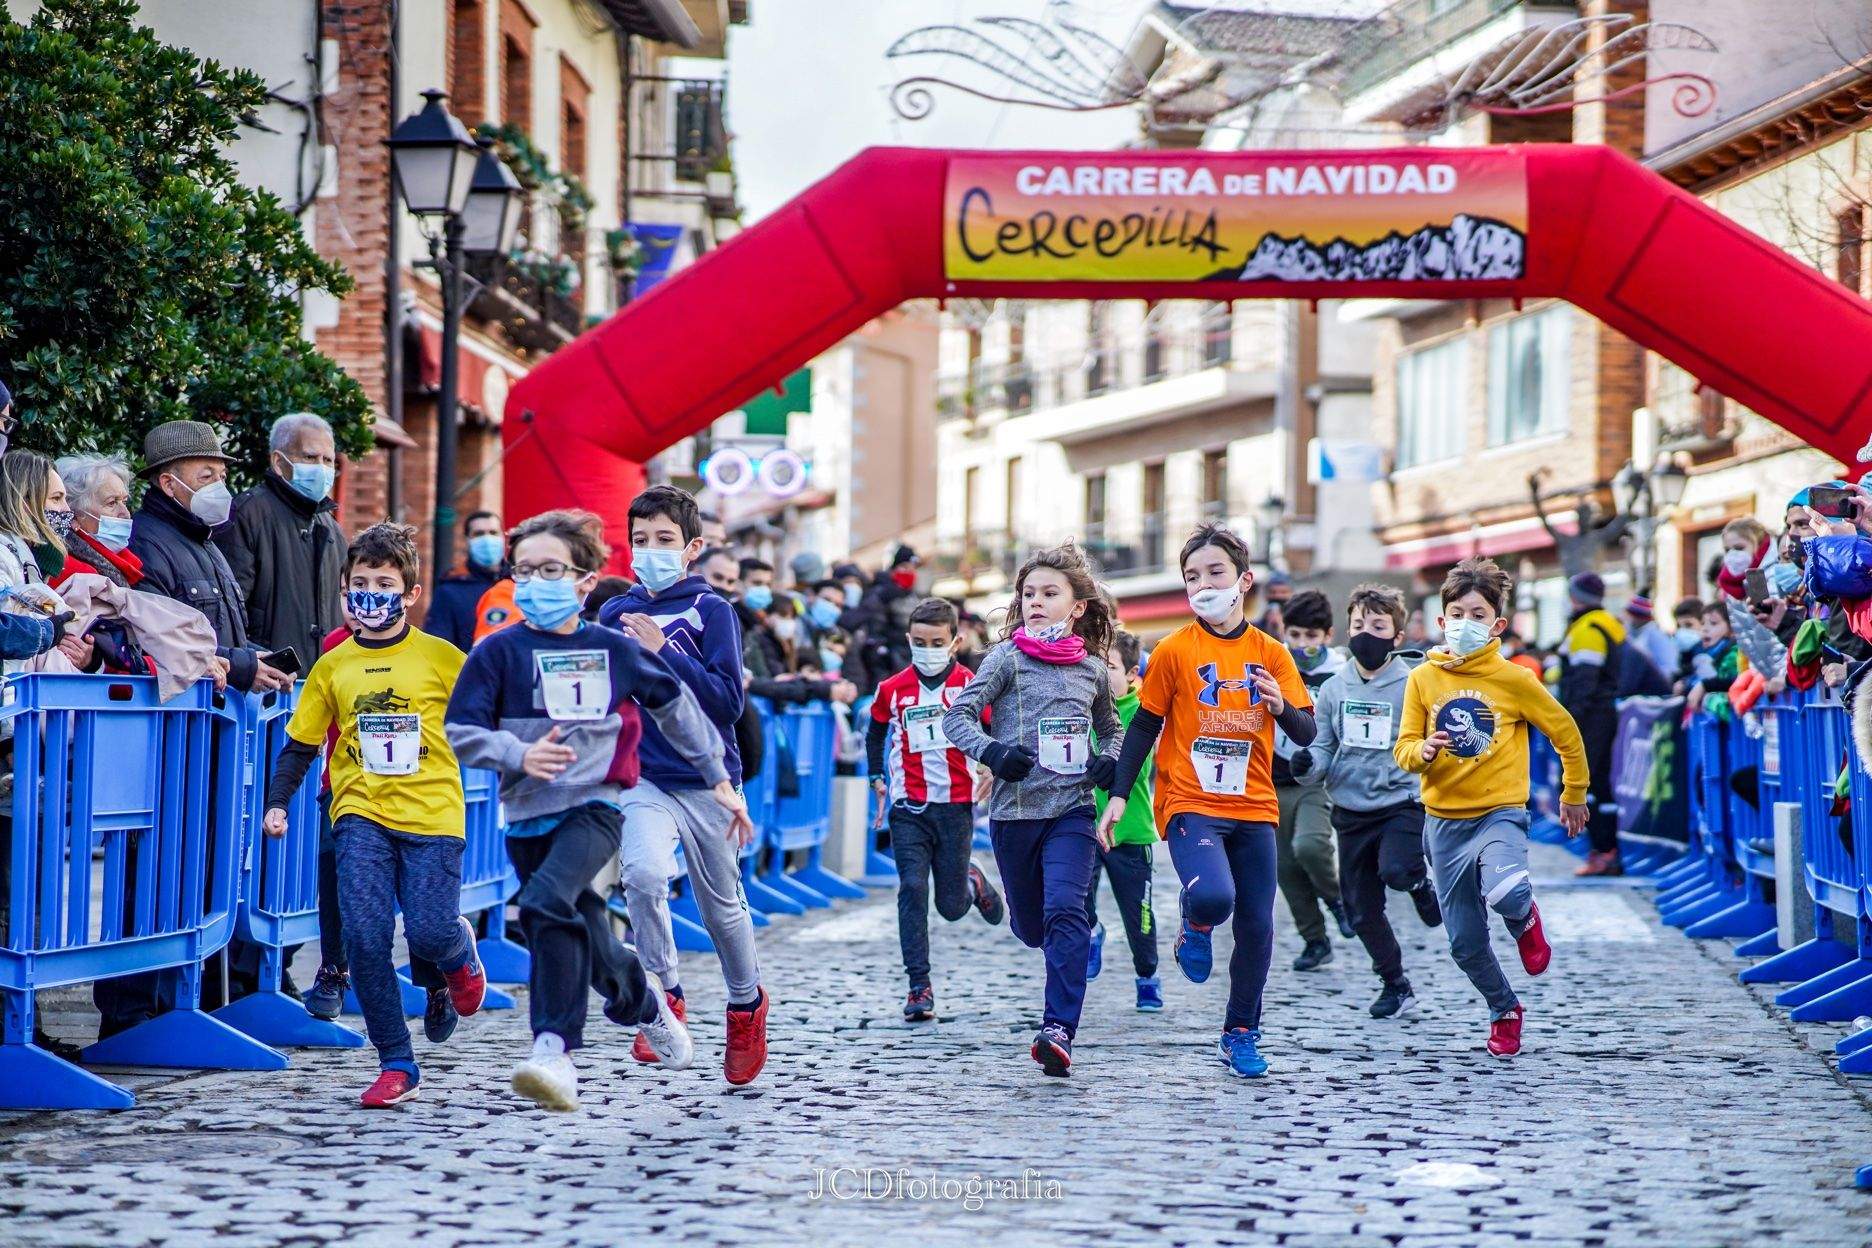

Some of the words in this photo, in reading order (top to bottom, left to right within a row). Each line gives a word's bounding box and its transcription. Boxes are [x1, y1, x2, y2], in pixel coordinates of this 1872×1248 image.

[1016, 166, 1218, 196] CARRERA
[1223, 175, 1261, 195] DE
[1266, 165, 1457, 195] NAVIDAD
[572, 681, 581, 705] 1
[1199, 708, 1264, 722] UNDER
[926, 724, 934, 740] 1
[1200, 721, 1264, 733] ARMOUR
[1363, 722, 1369, 738] 1
[383, 741, 393, 763] 1
[1063, 742, 1071, 762] 1
[1214, 763, 1224, 783] 1
